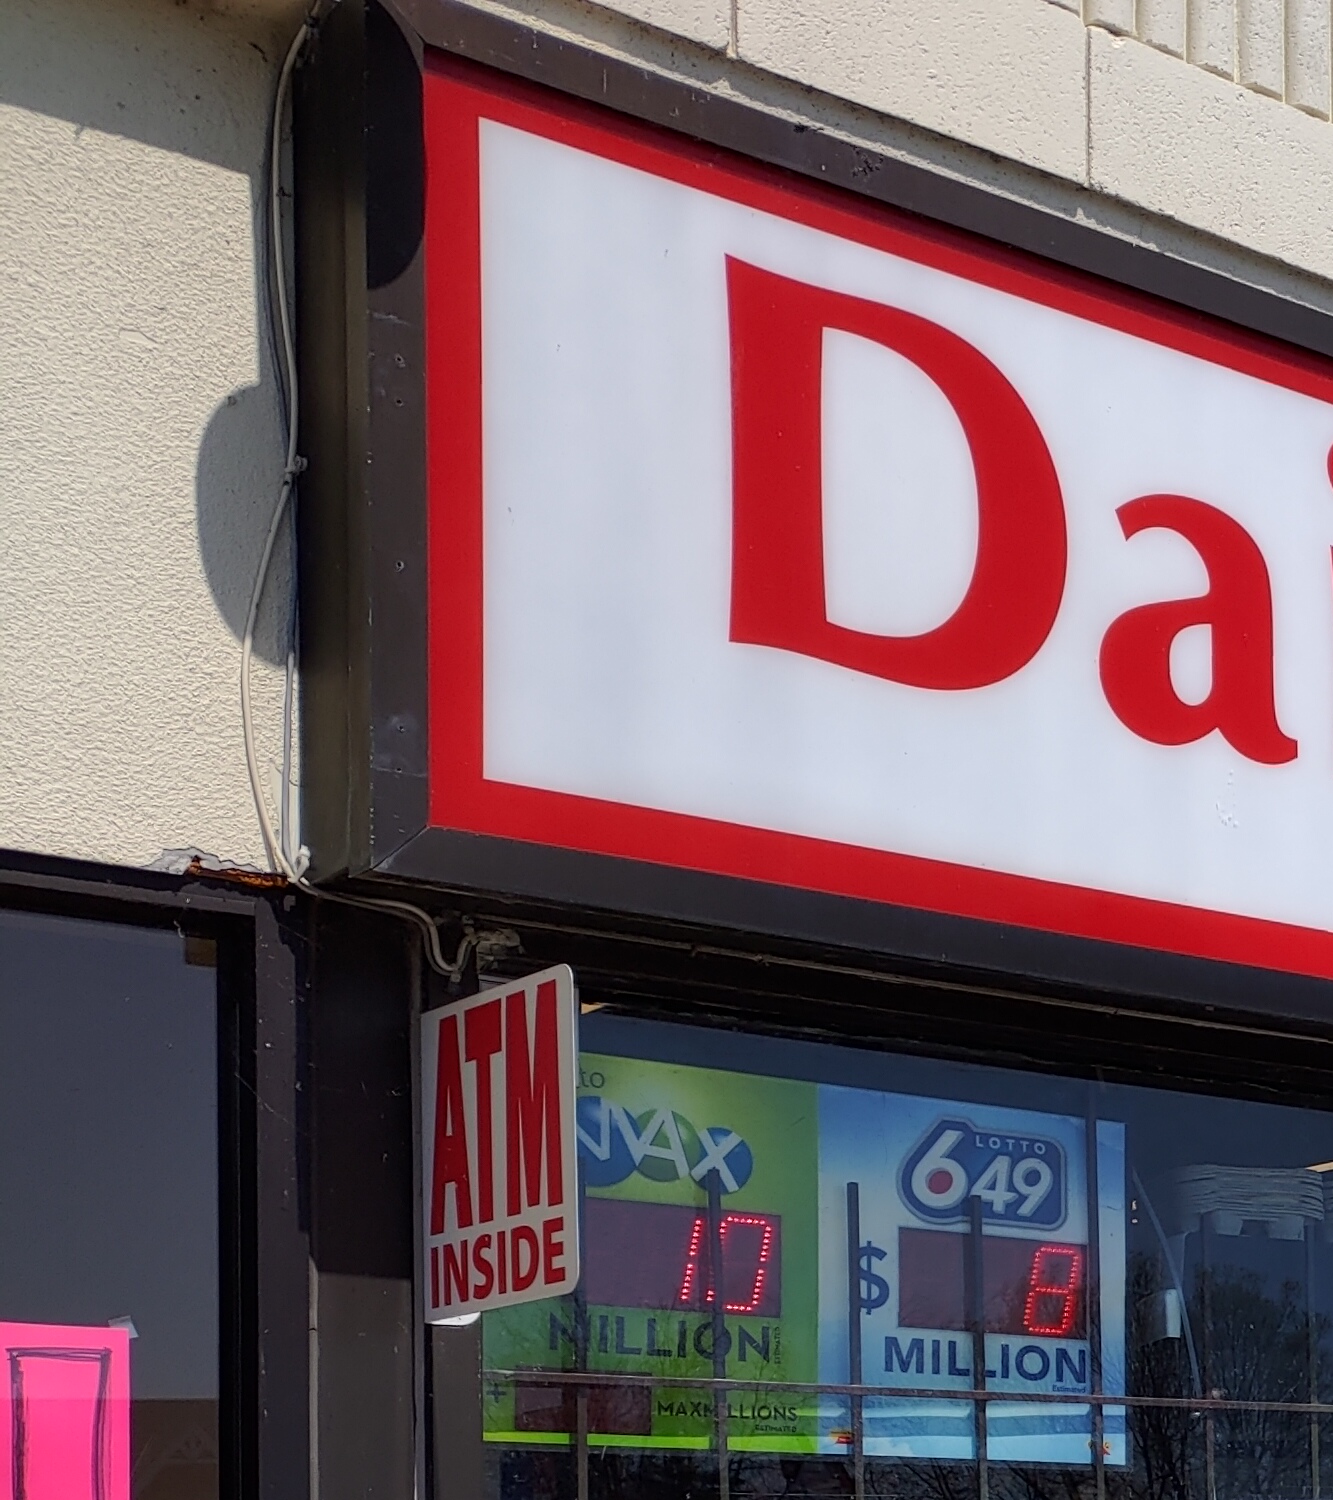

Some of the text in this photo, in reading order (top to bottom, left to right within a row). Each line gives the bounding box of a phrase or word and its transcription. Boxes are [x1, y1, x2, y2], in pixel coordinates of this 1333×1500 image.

[430, 978, 562, 1235] ATM
[974, 1133, 1046, 1156] LOTTO
[911, 1118, 1053, 1220] 649
[431, 1216, 566, 1309] INSIDE
[1023, 1244, 1081, 1335] 8
[885, 1335, 1088, 1385] MILLION
